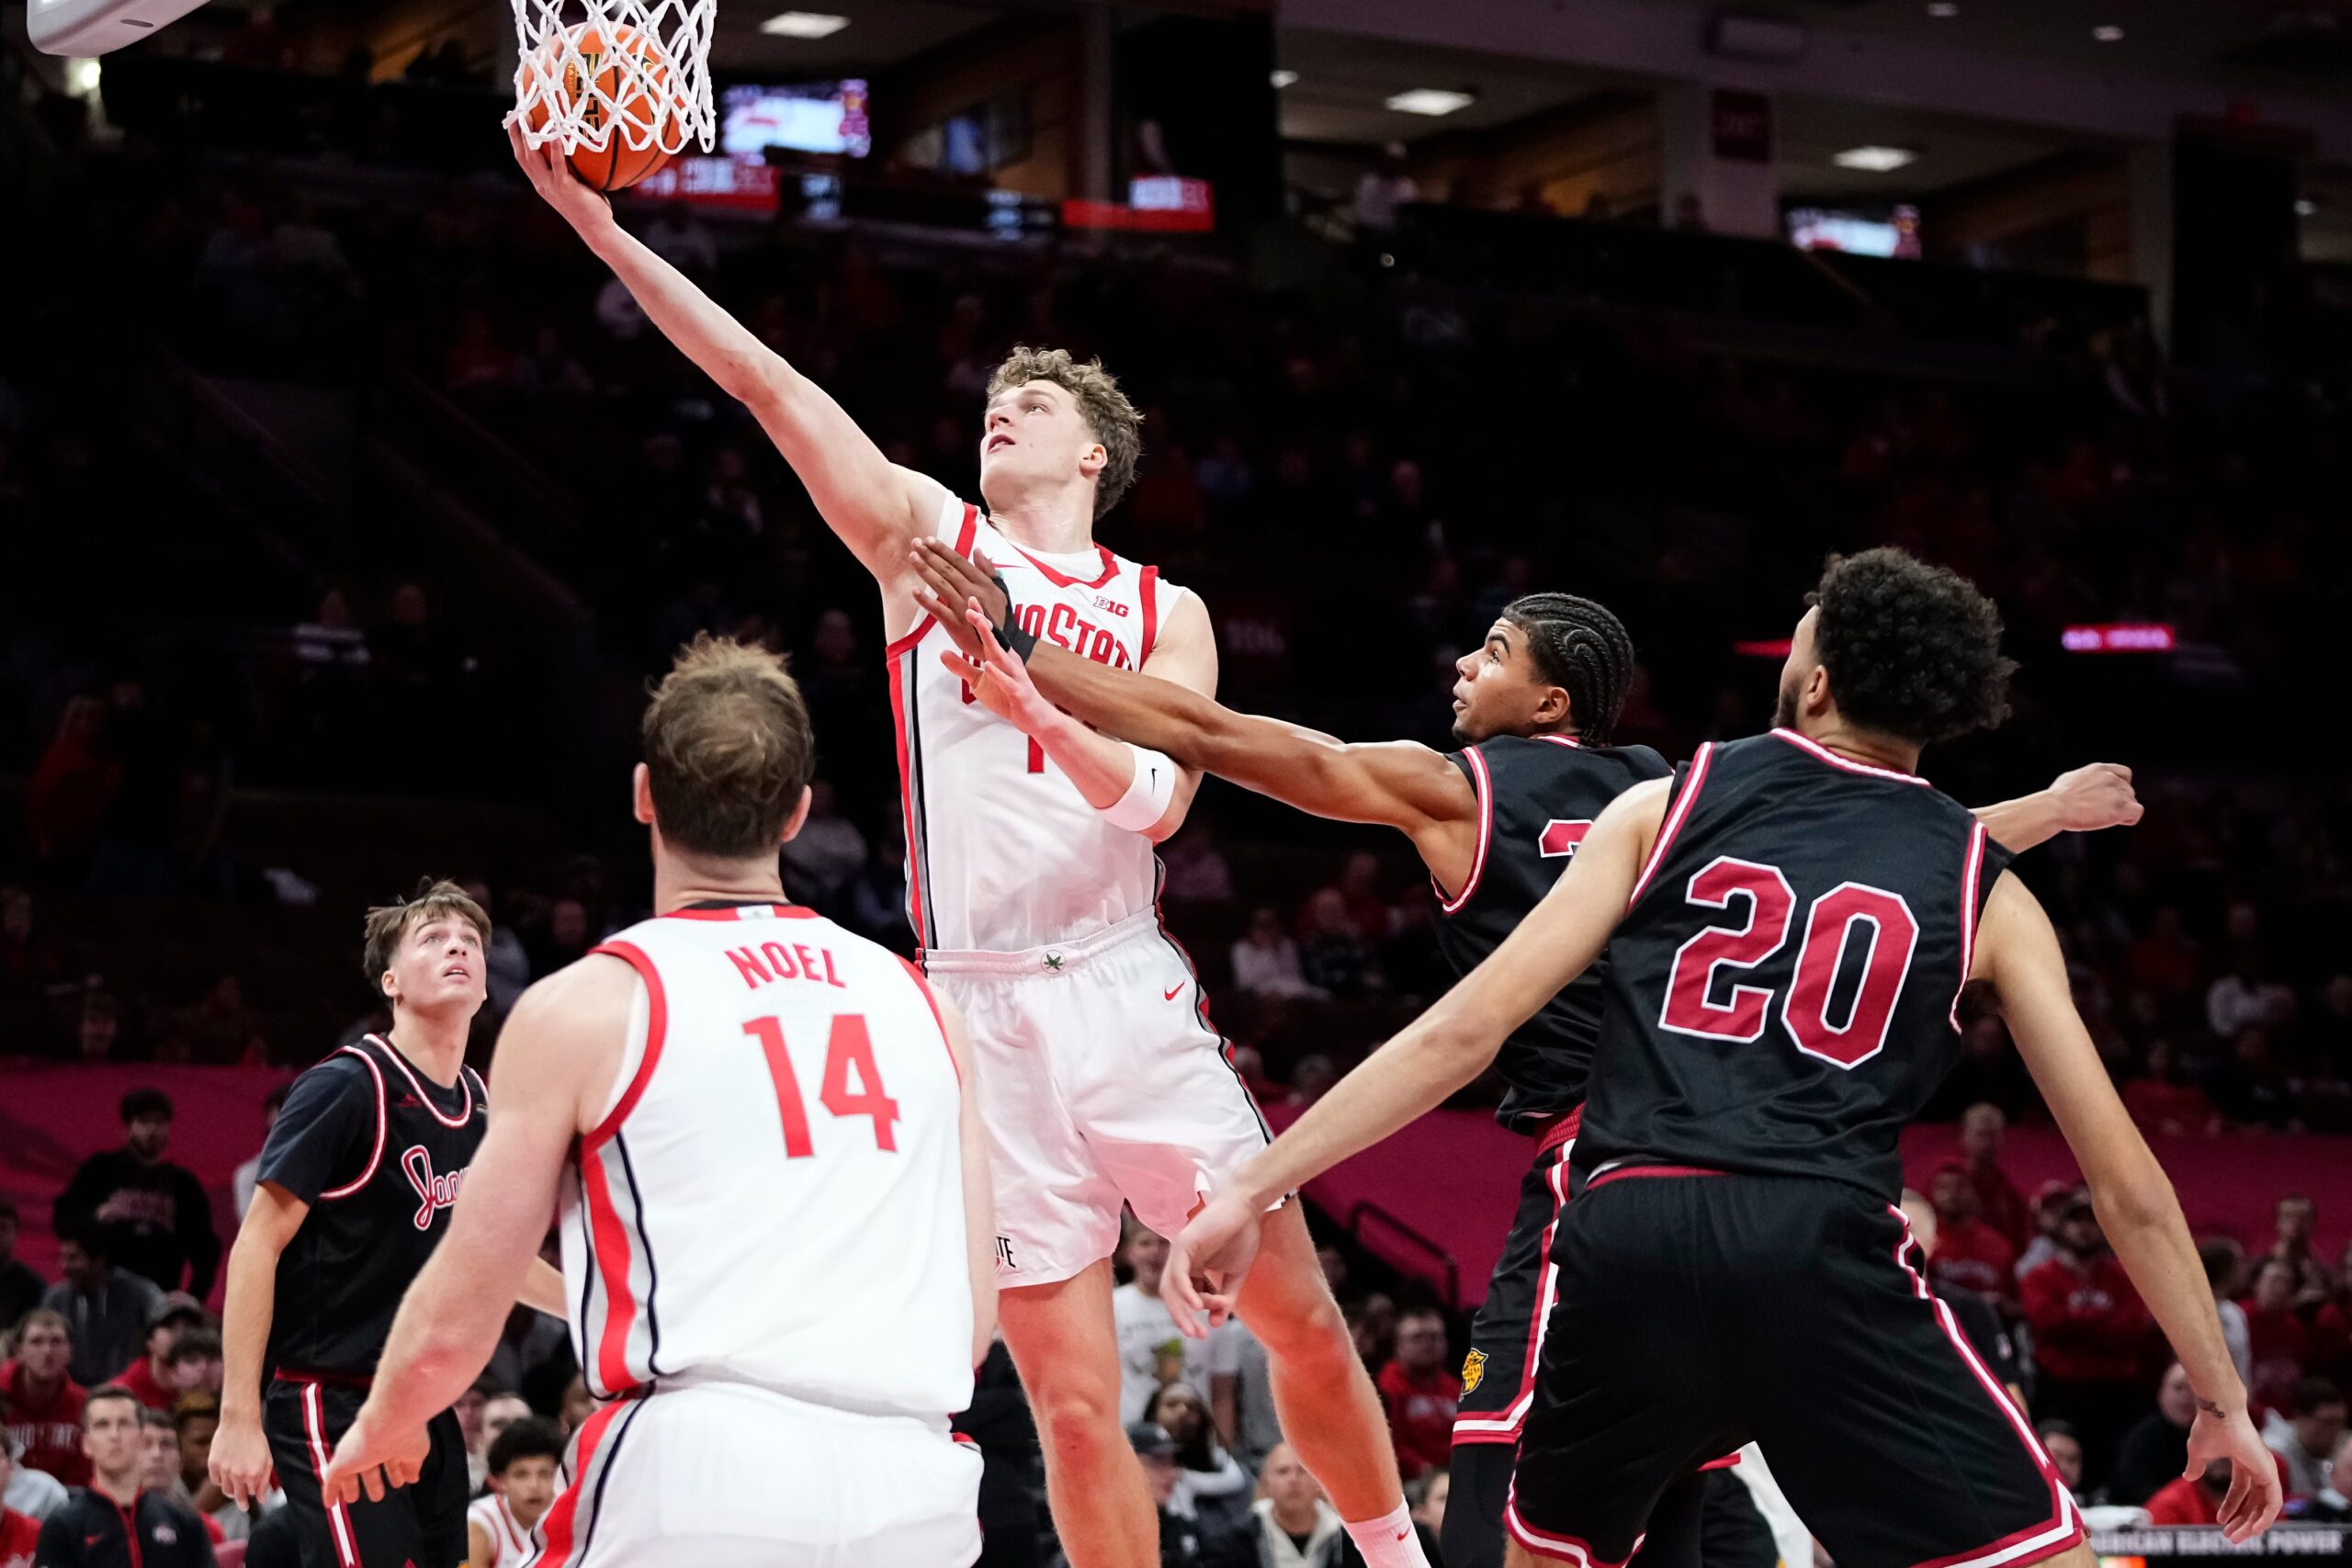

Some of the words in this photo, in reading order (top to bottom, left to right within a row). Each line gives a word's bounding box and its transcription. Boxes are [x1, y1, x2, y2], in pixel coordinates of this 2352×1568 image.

[724, 941, 847, 990] NOEL
[1658, 855, 1919, 1071] 20
[741, 1014, 901, 1159] 14
[2090, 1529, 2173, 1554] MERICAN
[2267, 1529, 2342, 1554] POWER
